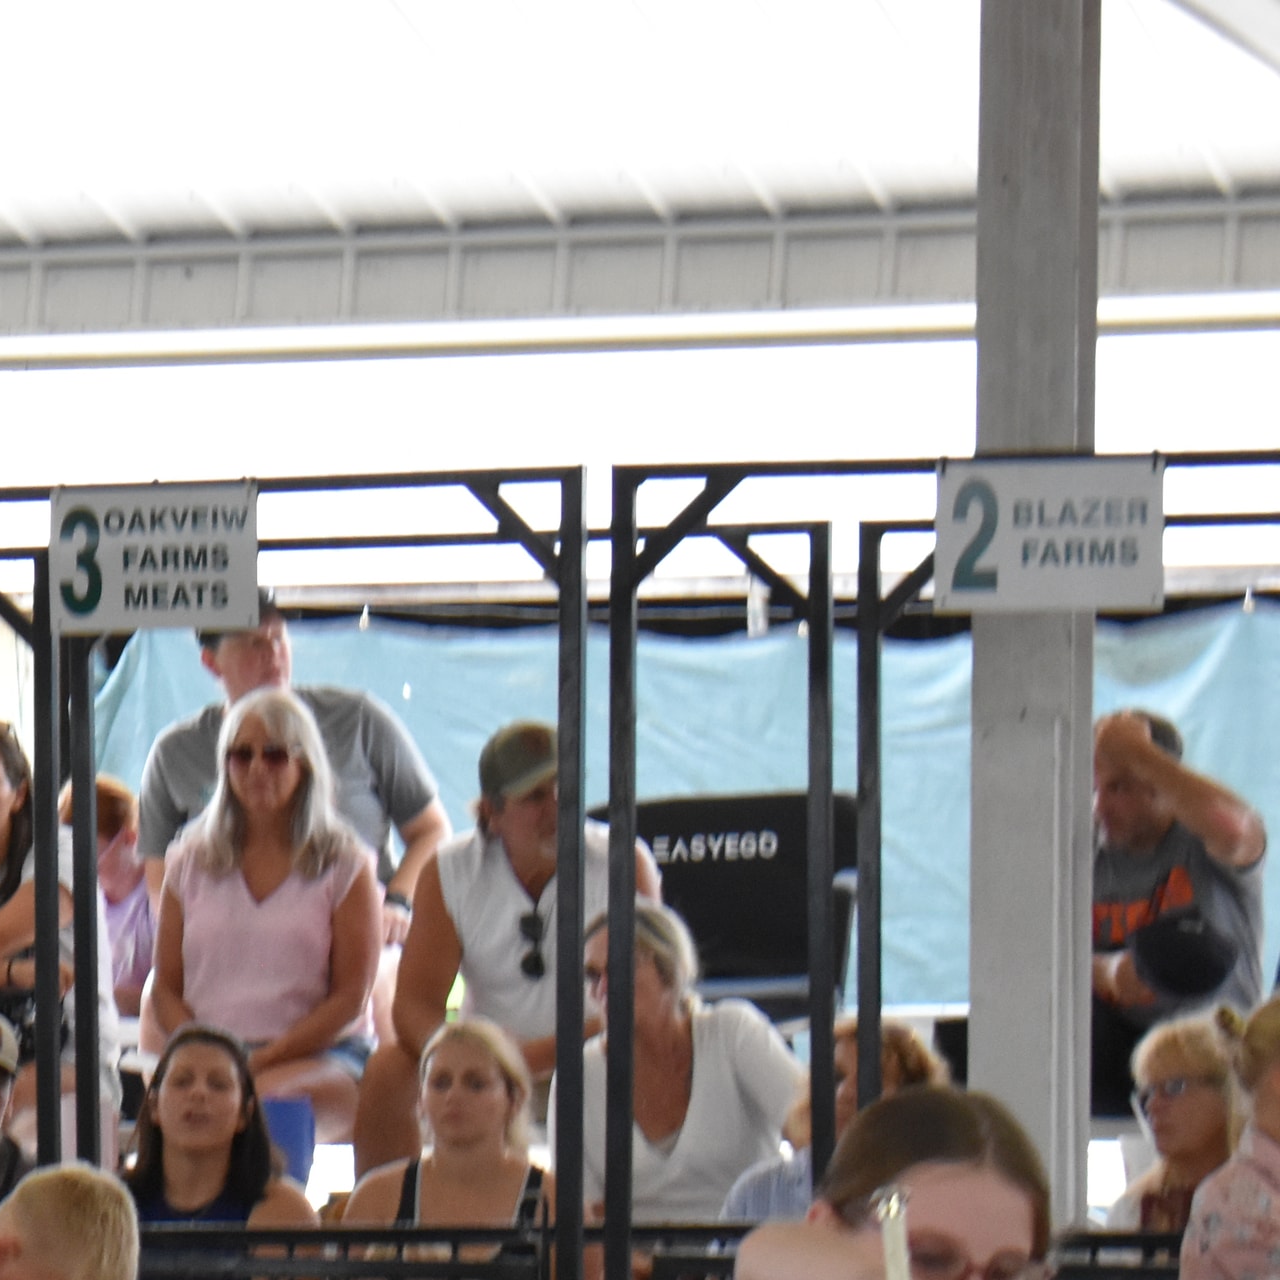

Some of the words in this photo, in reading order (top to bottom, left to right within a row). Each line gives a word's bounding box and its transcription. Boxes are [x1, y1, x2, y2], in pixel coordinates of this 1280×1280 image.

[103, 505, 249, 535] OAKVEIW
[1012, 498, 1148, 528] BLAZER
[952, 475, 998, 593] 2
[59, 504, 102, 618] 3
[122, 542, 230, 574] FARMS
[1021, 535, 1139, 568] FARMS
[123, 579, 230, 612] MEATS
